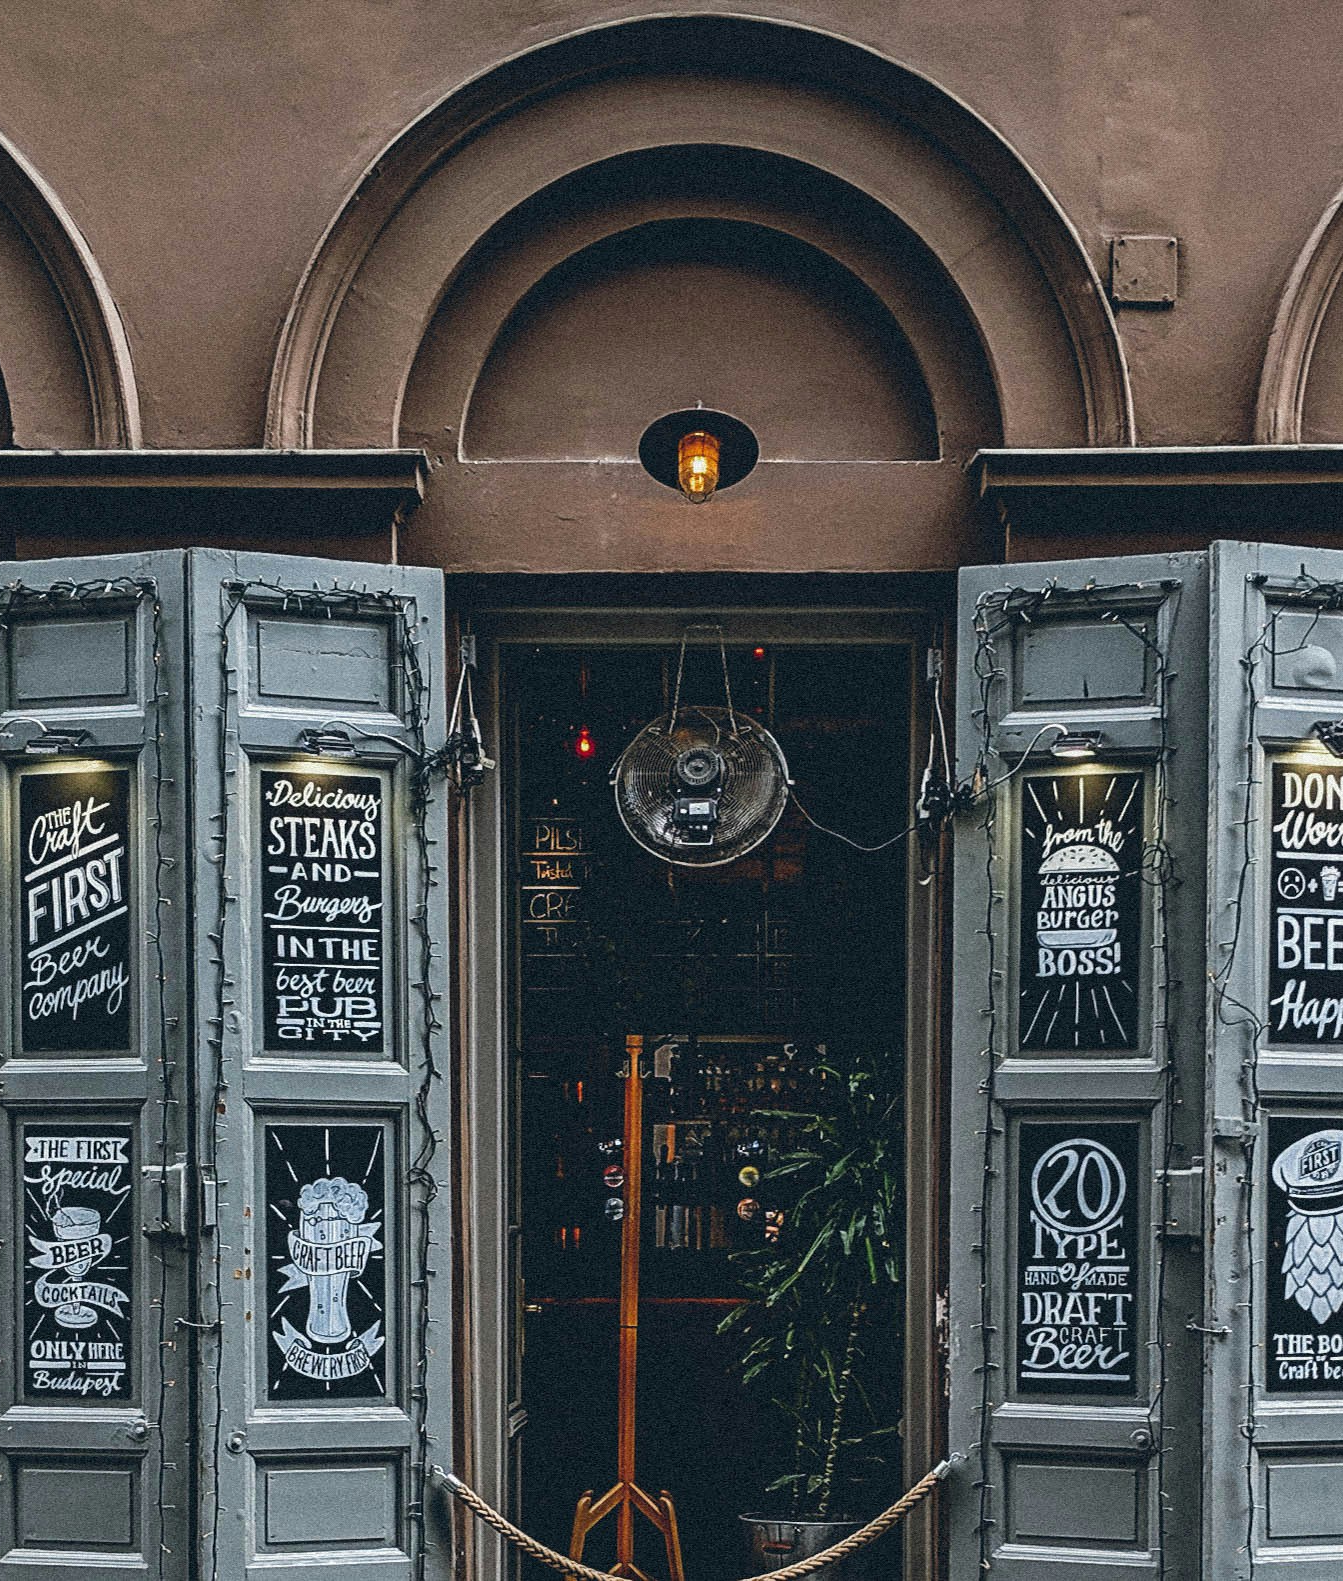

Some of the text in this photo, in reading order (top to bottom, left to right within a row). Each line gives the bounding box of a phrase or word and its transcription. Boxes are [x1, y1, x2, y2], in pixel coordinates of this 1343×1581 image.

[268, 780, 381, 821] Delicious
[29, 797, 110, 865] Craft
[45, 807, 71, 829] THE
[268, 817, 377, 859] STEAKS
[1042, 818, 1123, 857] from the
[291, 864, 352, 882] AND
[1040, 874, 1119, 885] delicious
[28, 845, 125, 945] FIRST
[264, 885, 383, 922] Burgers
[1042, 885, 1115, 908] ANGUS
[277, 935, 380, 960] IN THE
[1035, 941, 1121, 977] BOSS!
[24, 935, 109, 991] Beer
[29, 961, 129, 1021] company
[277, 968, 376, 998] best beer
[276, 996, 377, 1018] PUB
[278, 1026, 379, 1041] CITY
[306, 1018, 351, 1028] IN THE
[39, 1140, 121, 1160] THE FIRST
[1302, 1148, 1336, 1174] FIRST
[1043, 1149, 1111, 1221] 20
[1030, 1210, 1125, 1259] TYPE
[52, 1238, 104, 1266] BEER
[293, 1245, 365, 1271] CRAFT BEER
[1025, 1272, 1127, 1285] HAND MADE
[41, 1285, 119, 1304] COCKTAILS
[1022, 1292, 1132, 1325] DRAFT
[30, 1340, 123, 1360] ONLY HERE
[1022, 1327, 1129, 1369] Beer
[1060, 1327, 1128, 1352] CRAFT
[1273, 1334, 1314, 1354] THE
[288, 1345, 343, 1378] BREWERY
[1279, 1360, 1318, 1380] Craft
[32, 1370, 121, 1396] Budapest
